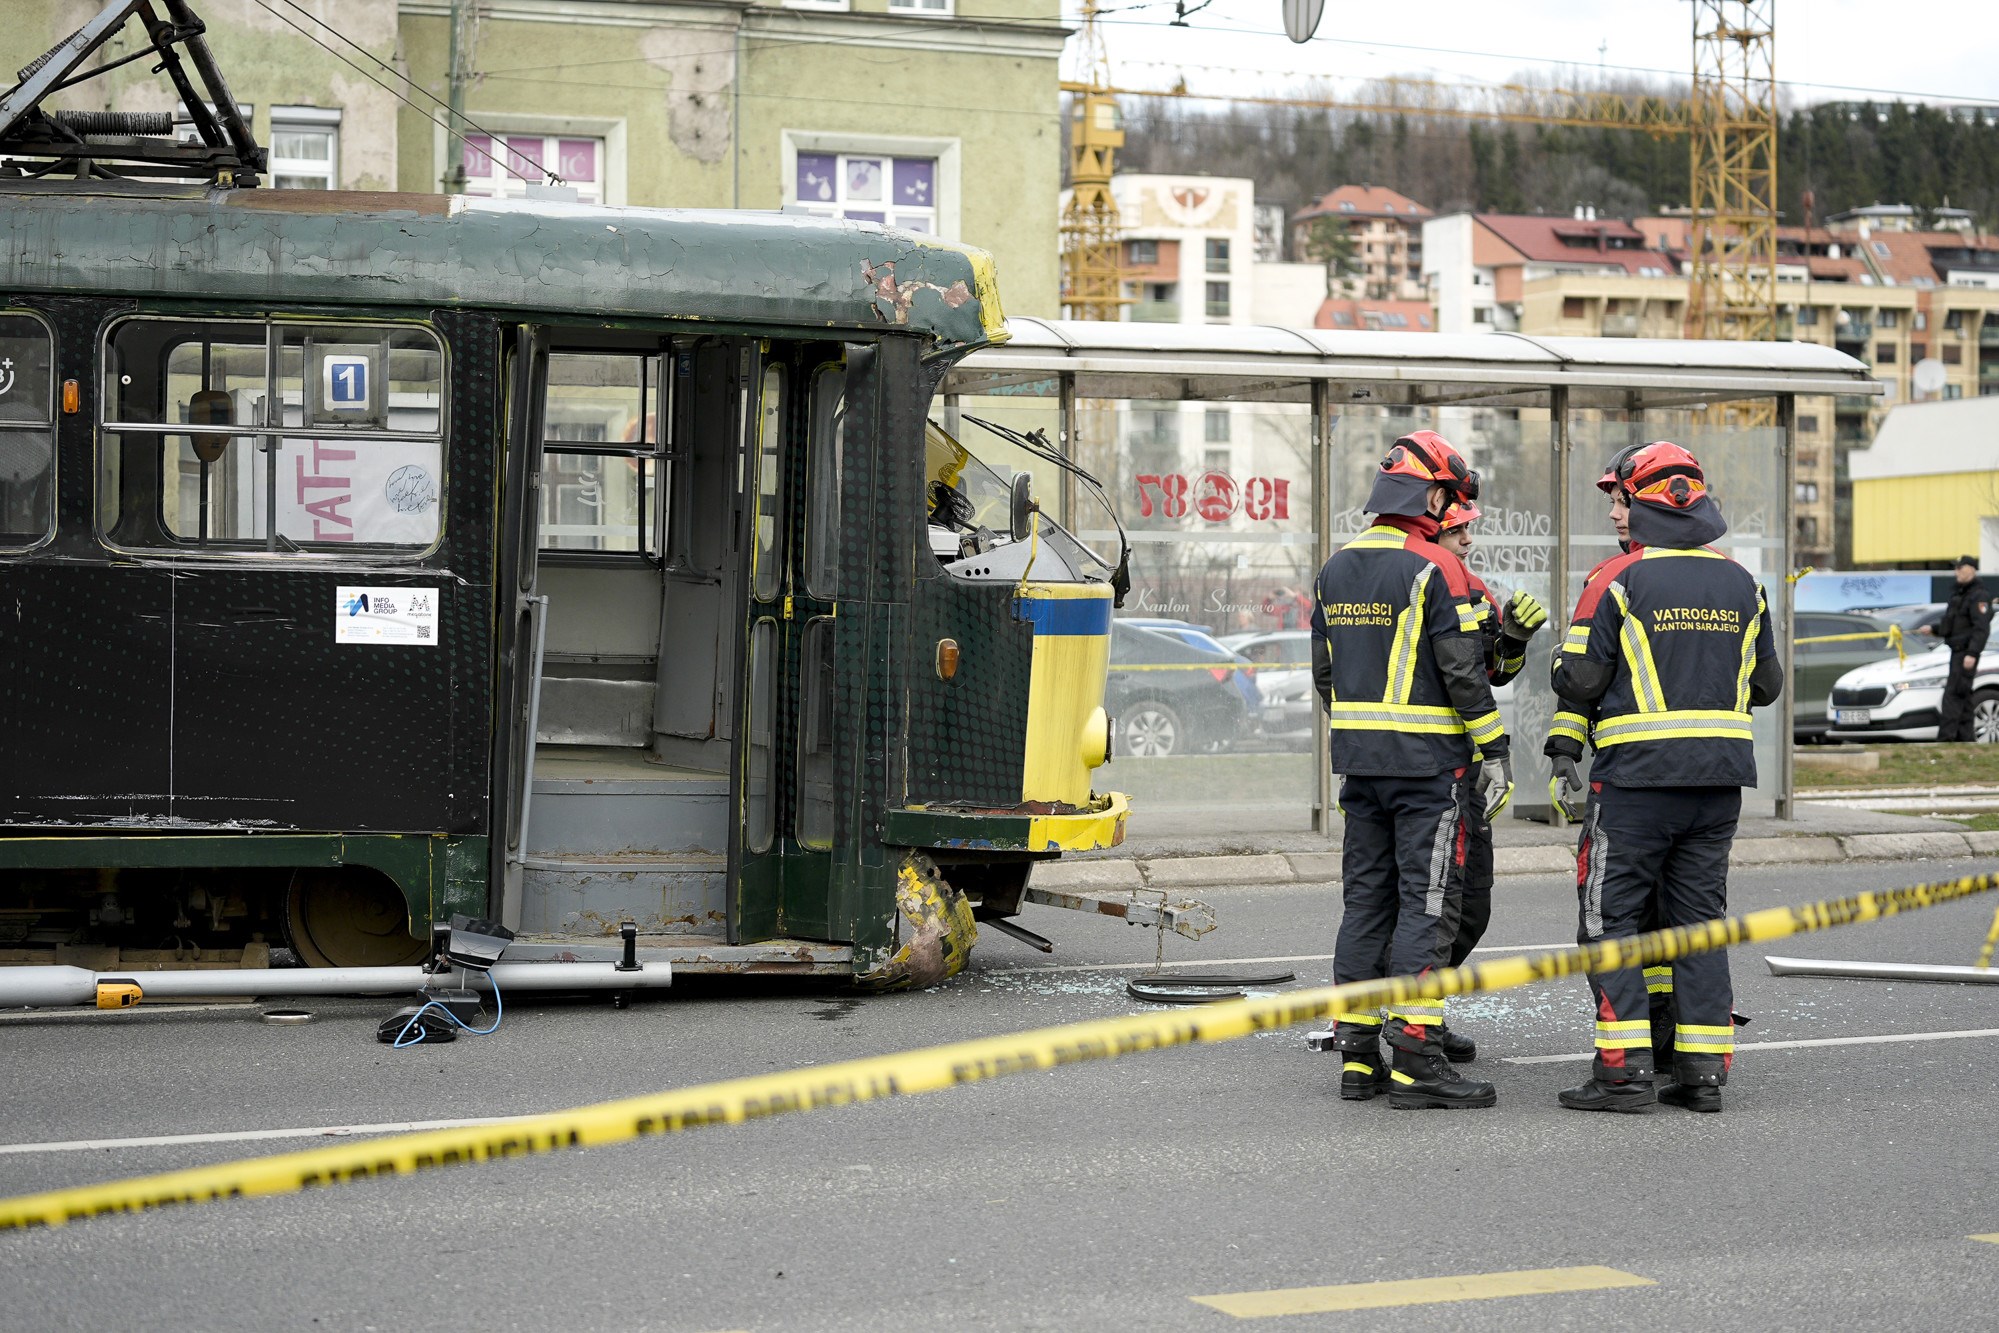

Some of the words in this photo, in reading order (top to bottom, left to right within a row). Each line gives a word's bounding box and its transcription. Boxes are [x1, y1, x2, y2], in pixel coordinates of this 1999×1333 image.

[338, 366, 355, 400] 1
[1123, 588, 1190, 613] Kanton
[1204, 588, 1275, 614] Sarajevo
[1327, 602, 1392, 616] VATROGASCI
[1652, 608, 1739, 623] VATROGASCI
[1327, 617, 1354, 626] KANTON
[1355, 616, 1392, 627] SARAJEVO
[1653, 622, 1694, 632] KANTON
[1696, 622, 1740, 634] SARAJEVO
